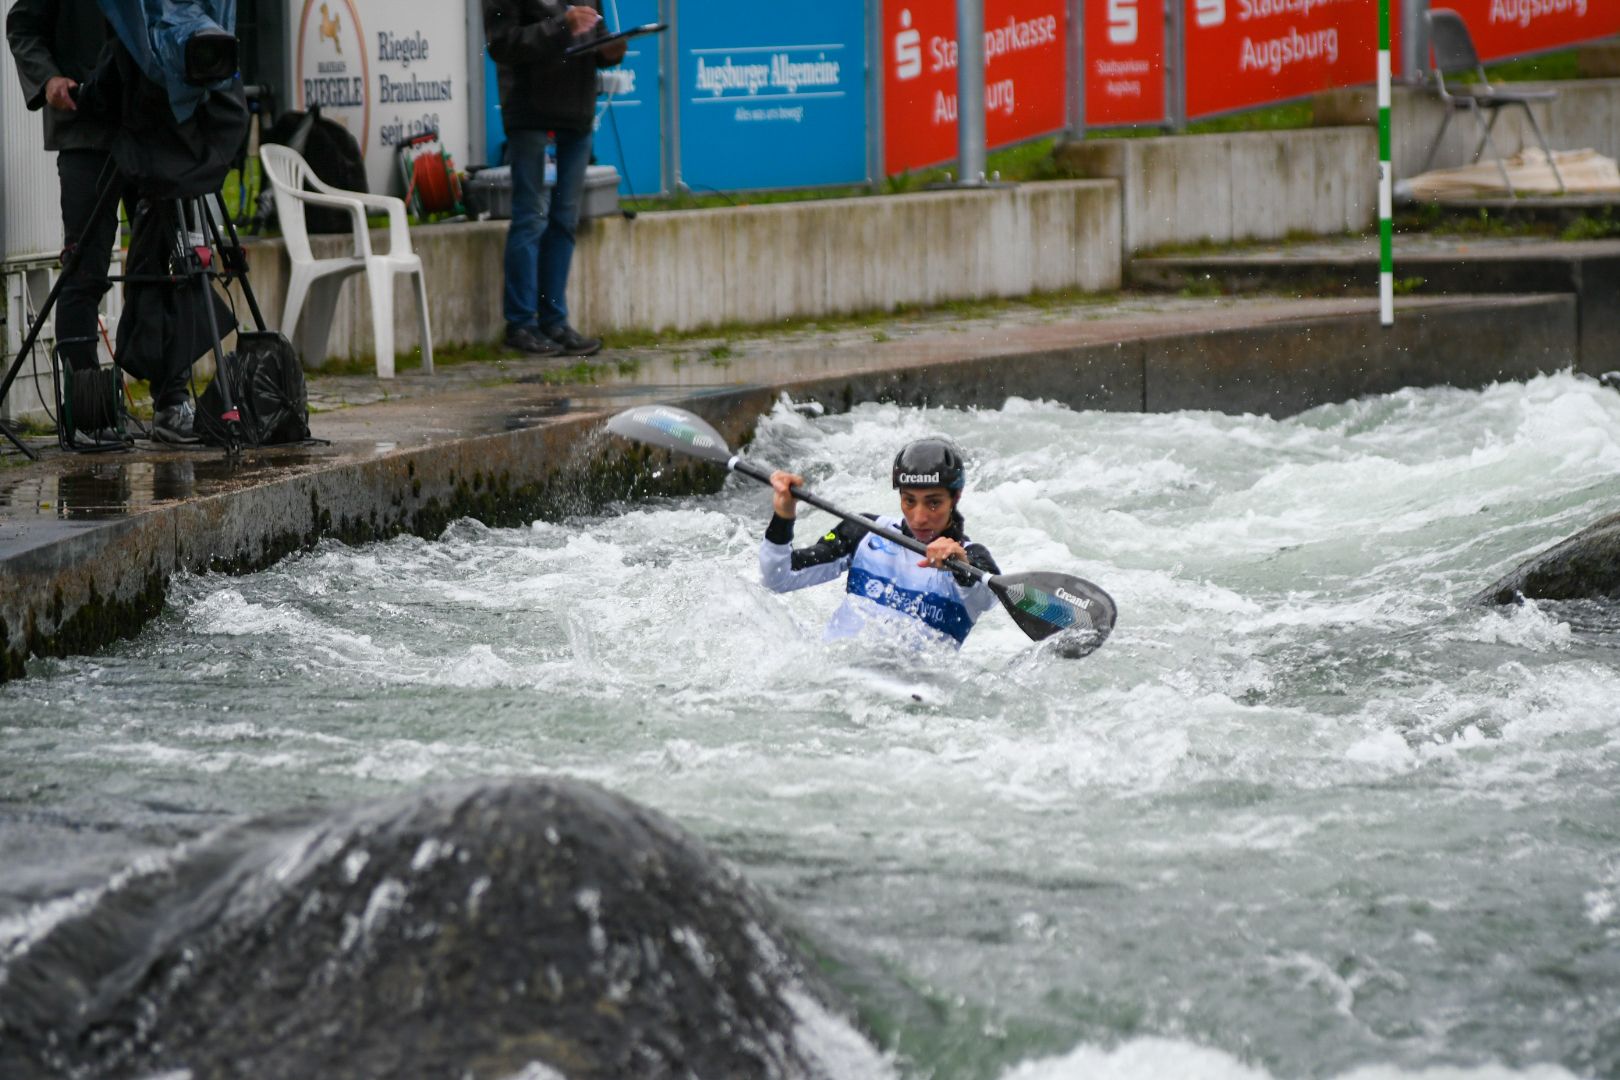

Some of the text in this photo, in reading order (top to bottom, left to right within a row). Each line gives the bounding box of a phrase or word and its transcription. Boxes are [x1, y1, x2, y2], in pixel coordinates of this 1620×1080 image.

[377, 30, 429, 68] Riegele
[931, 14, 1056, 73] Staparkasse
[1240, 25, 1339, 74] Augsburg
[379, 73, 452, 103] Braukunst
[696, 53, 840, 96] Augsburger Allgemeine
[304, 77, 363, 107] RIEGELE
[934, 79, 1015, 124] Auurg
[381, 115, 403, 146] seit
[899, 471, 940, 485] Creand
[1055, 587, 1091, 610] Creand
